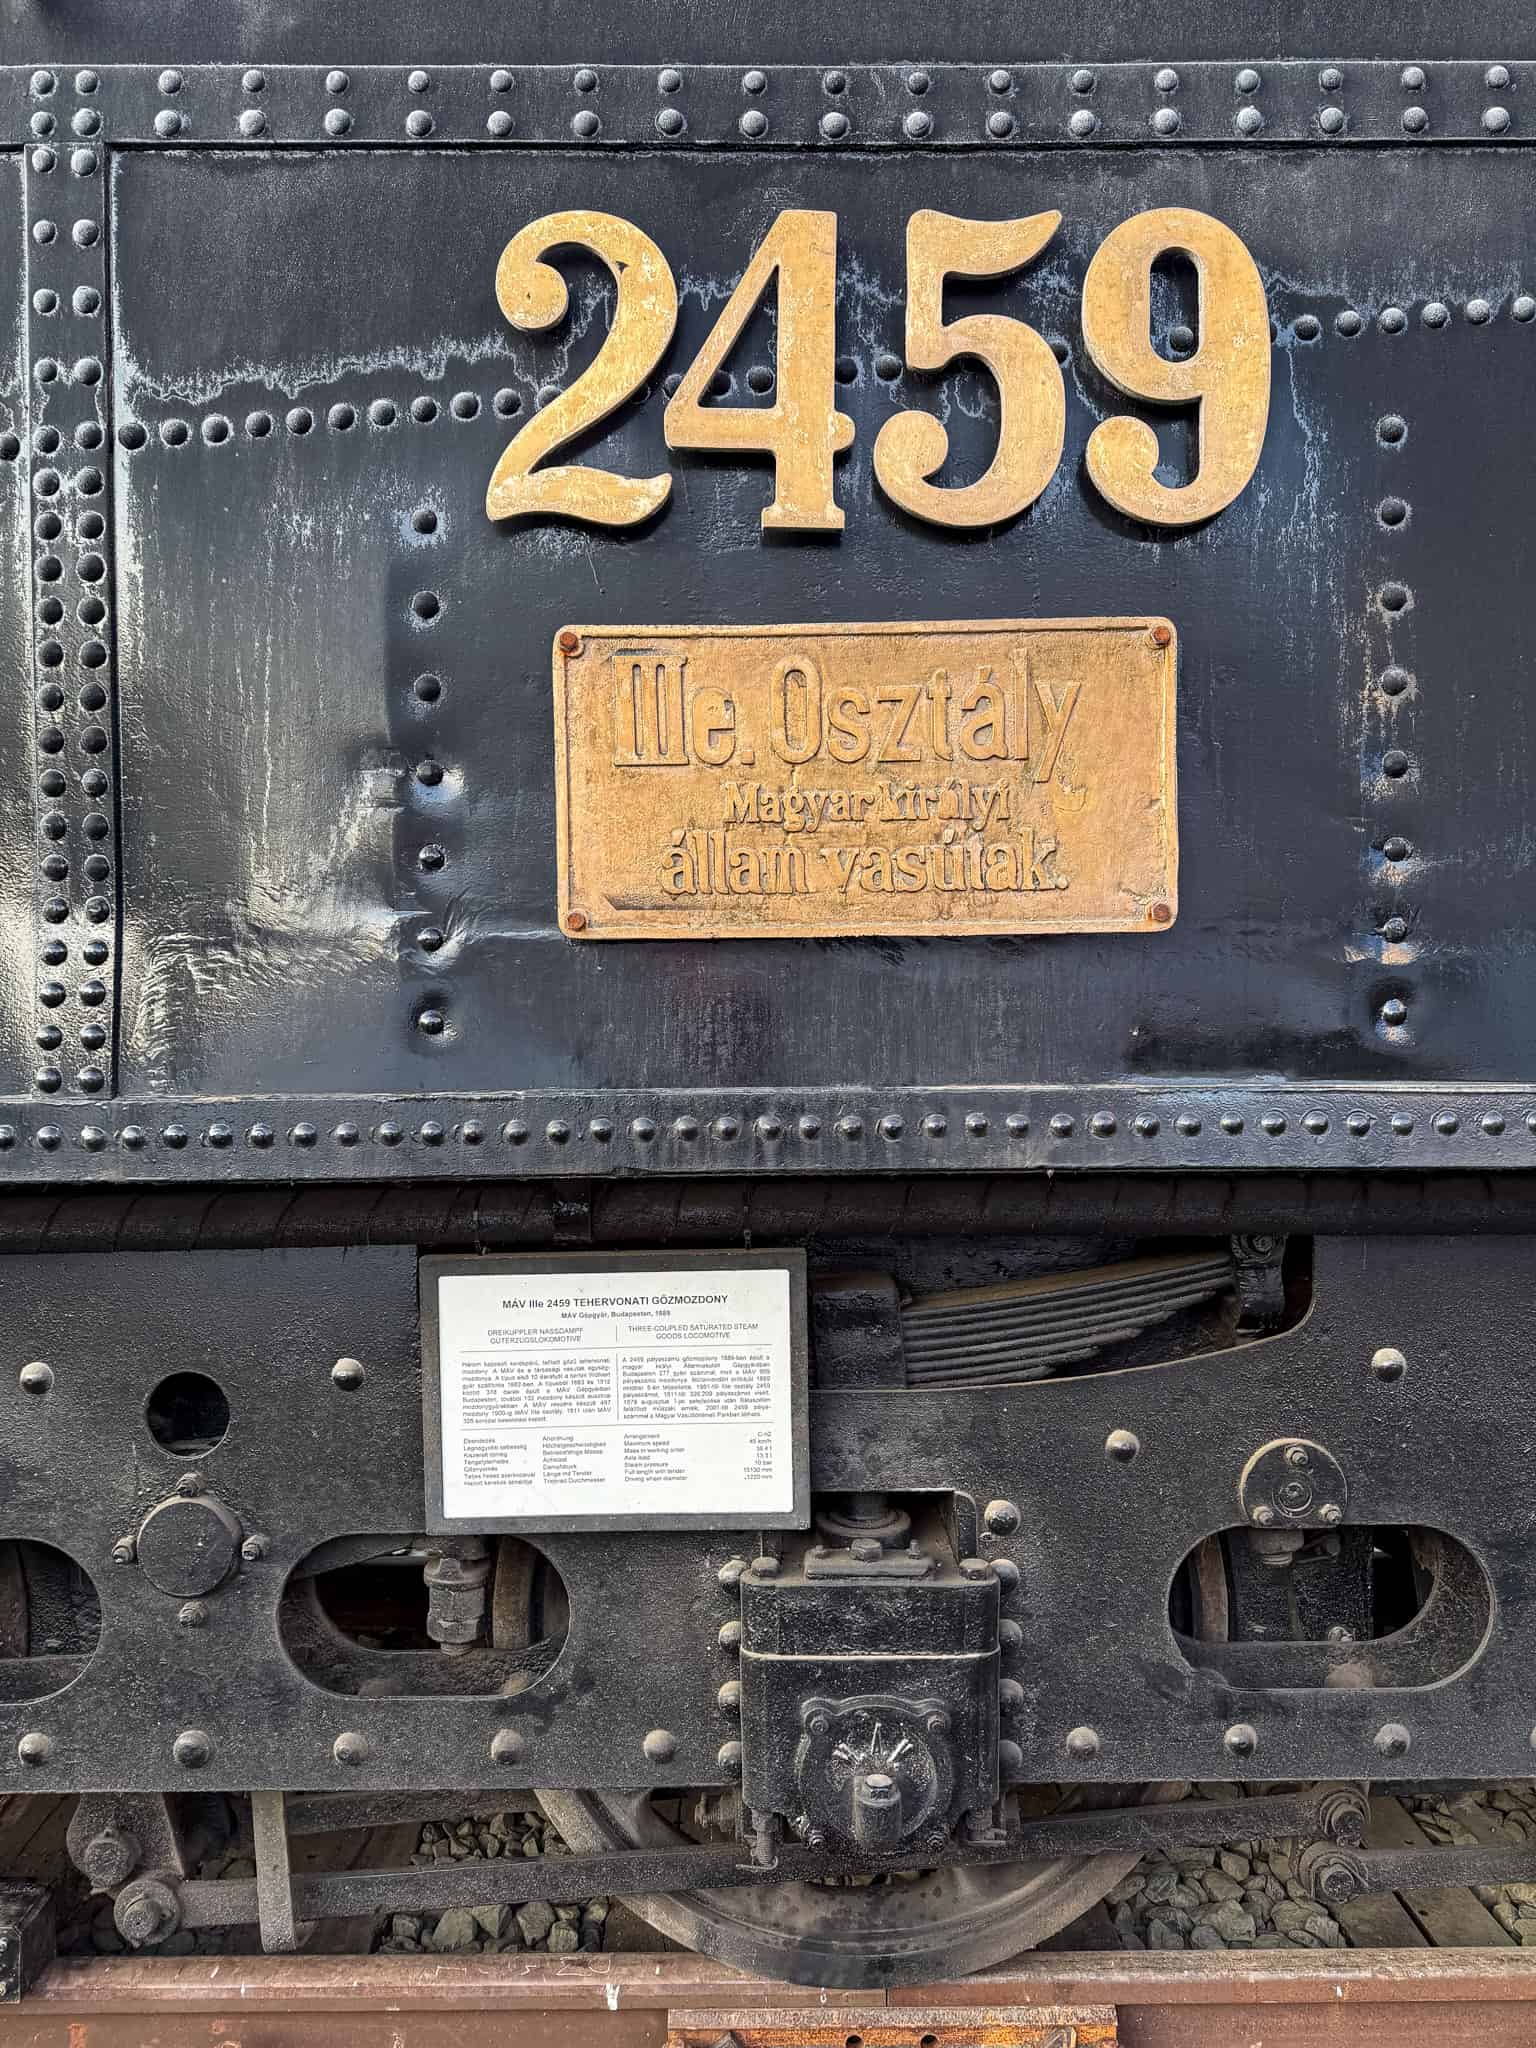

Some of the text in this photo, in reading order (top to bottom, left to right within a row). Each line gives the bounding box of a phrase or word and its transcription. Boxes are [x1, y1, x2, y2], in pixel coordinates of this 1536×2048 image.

[486, 207, 1272, 530] 2459
[772, 648, 1082, 783] Osztály
[724, 780, 873, 833] Magyar
[661, 830, 812, 896] állam
[502, 1297, 526, 1309] MÁV
[546, 1298, 571, 1308] 2459
[573, 1296, 649, 1307] TEHERVONATI
[689, 1323, 733, 1331] SATURATED
[734, 1322, 759, 1330] STEAM
[683, 1331, 731, 1339] LOCOMOTIVE
